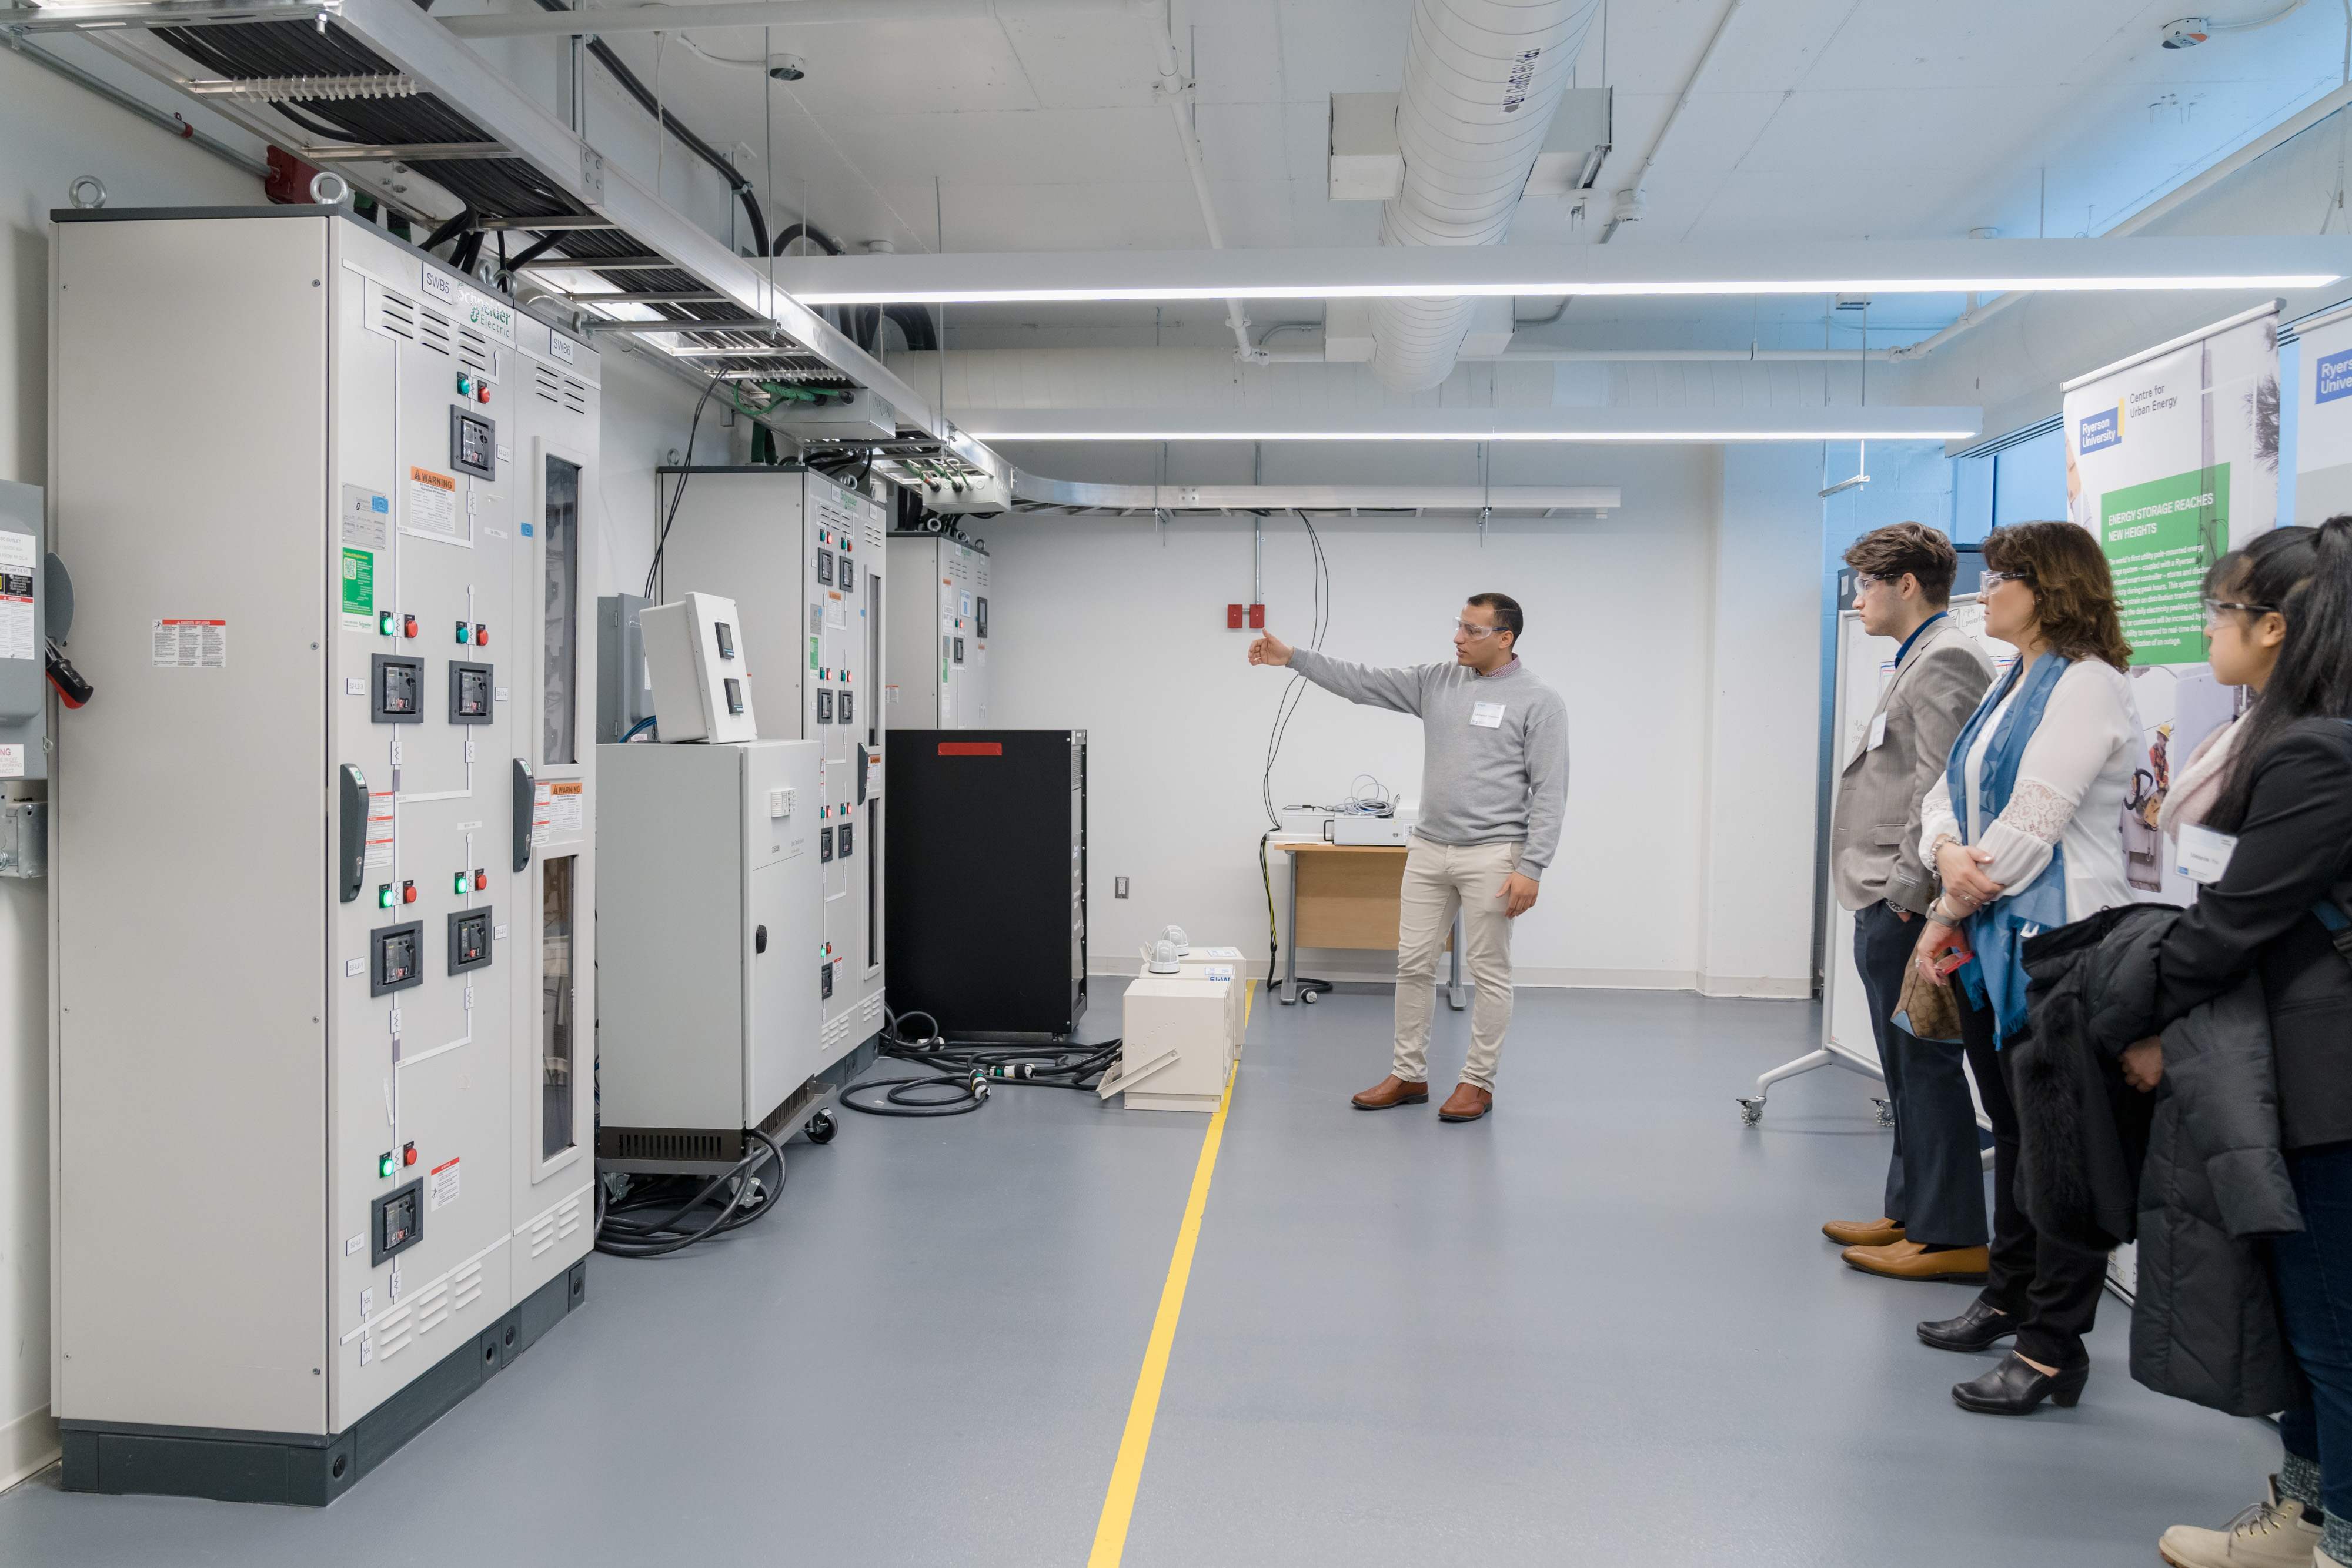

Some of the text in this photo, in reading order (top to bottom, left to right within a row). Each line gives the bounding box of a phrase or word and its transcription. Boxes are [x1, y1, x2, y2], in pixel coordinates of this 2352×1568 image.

[1505, 72, 1534, 94] SUPPLY
[1503, 93, 1526, 105] AIR
[427, 272, 449, 294] SWB5
[457, 282, 512, 325] Schneider
[480, 315, 510, 338] Electric
[554, 338, 570, 356] SWB6
[2130, 385, 2164, 404] Centre for
[2130, 396, 2178, 419] Urban Energy
[2082, 418, 2110, 436] Ryerson
[2082, 430, 2116, 448] University
[422, 473, 452, 490] WARNING
[2109, 493, 2214, 526] ENERGY STORAGE REACHES
[2108, 523, 2157, 542] NEW HEIGHTS
[2154, 546, 2187, 559] pole-mounted
[2187, 544, 2204, 553] energy
[2175, 557, 2196, 567] Ryerson
[559, 785, 580, 794] WARNING
